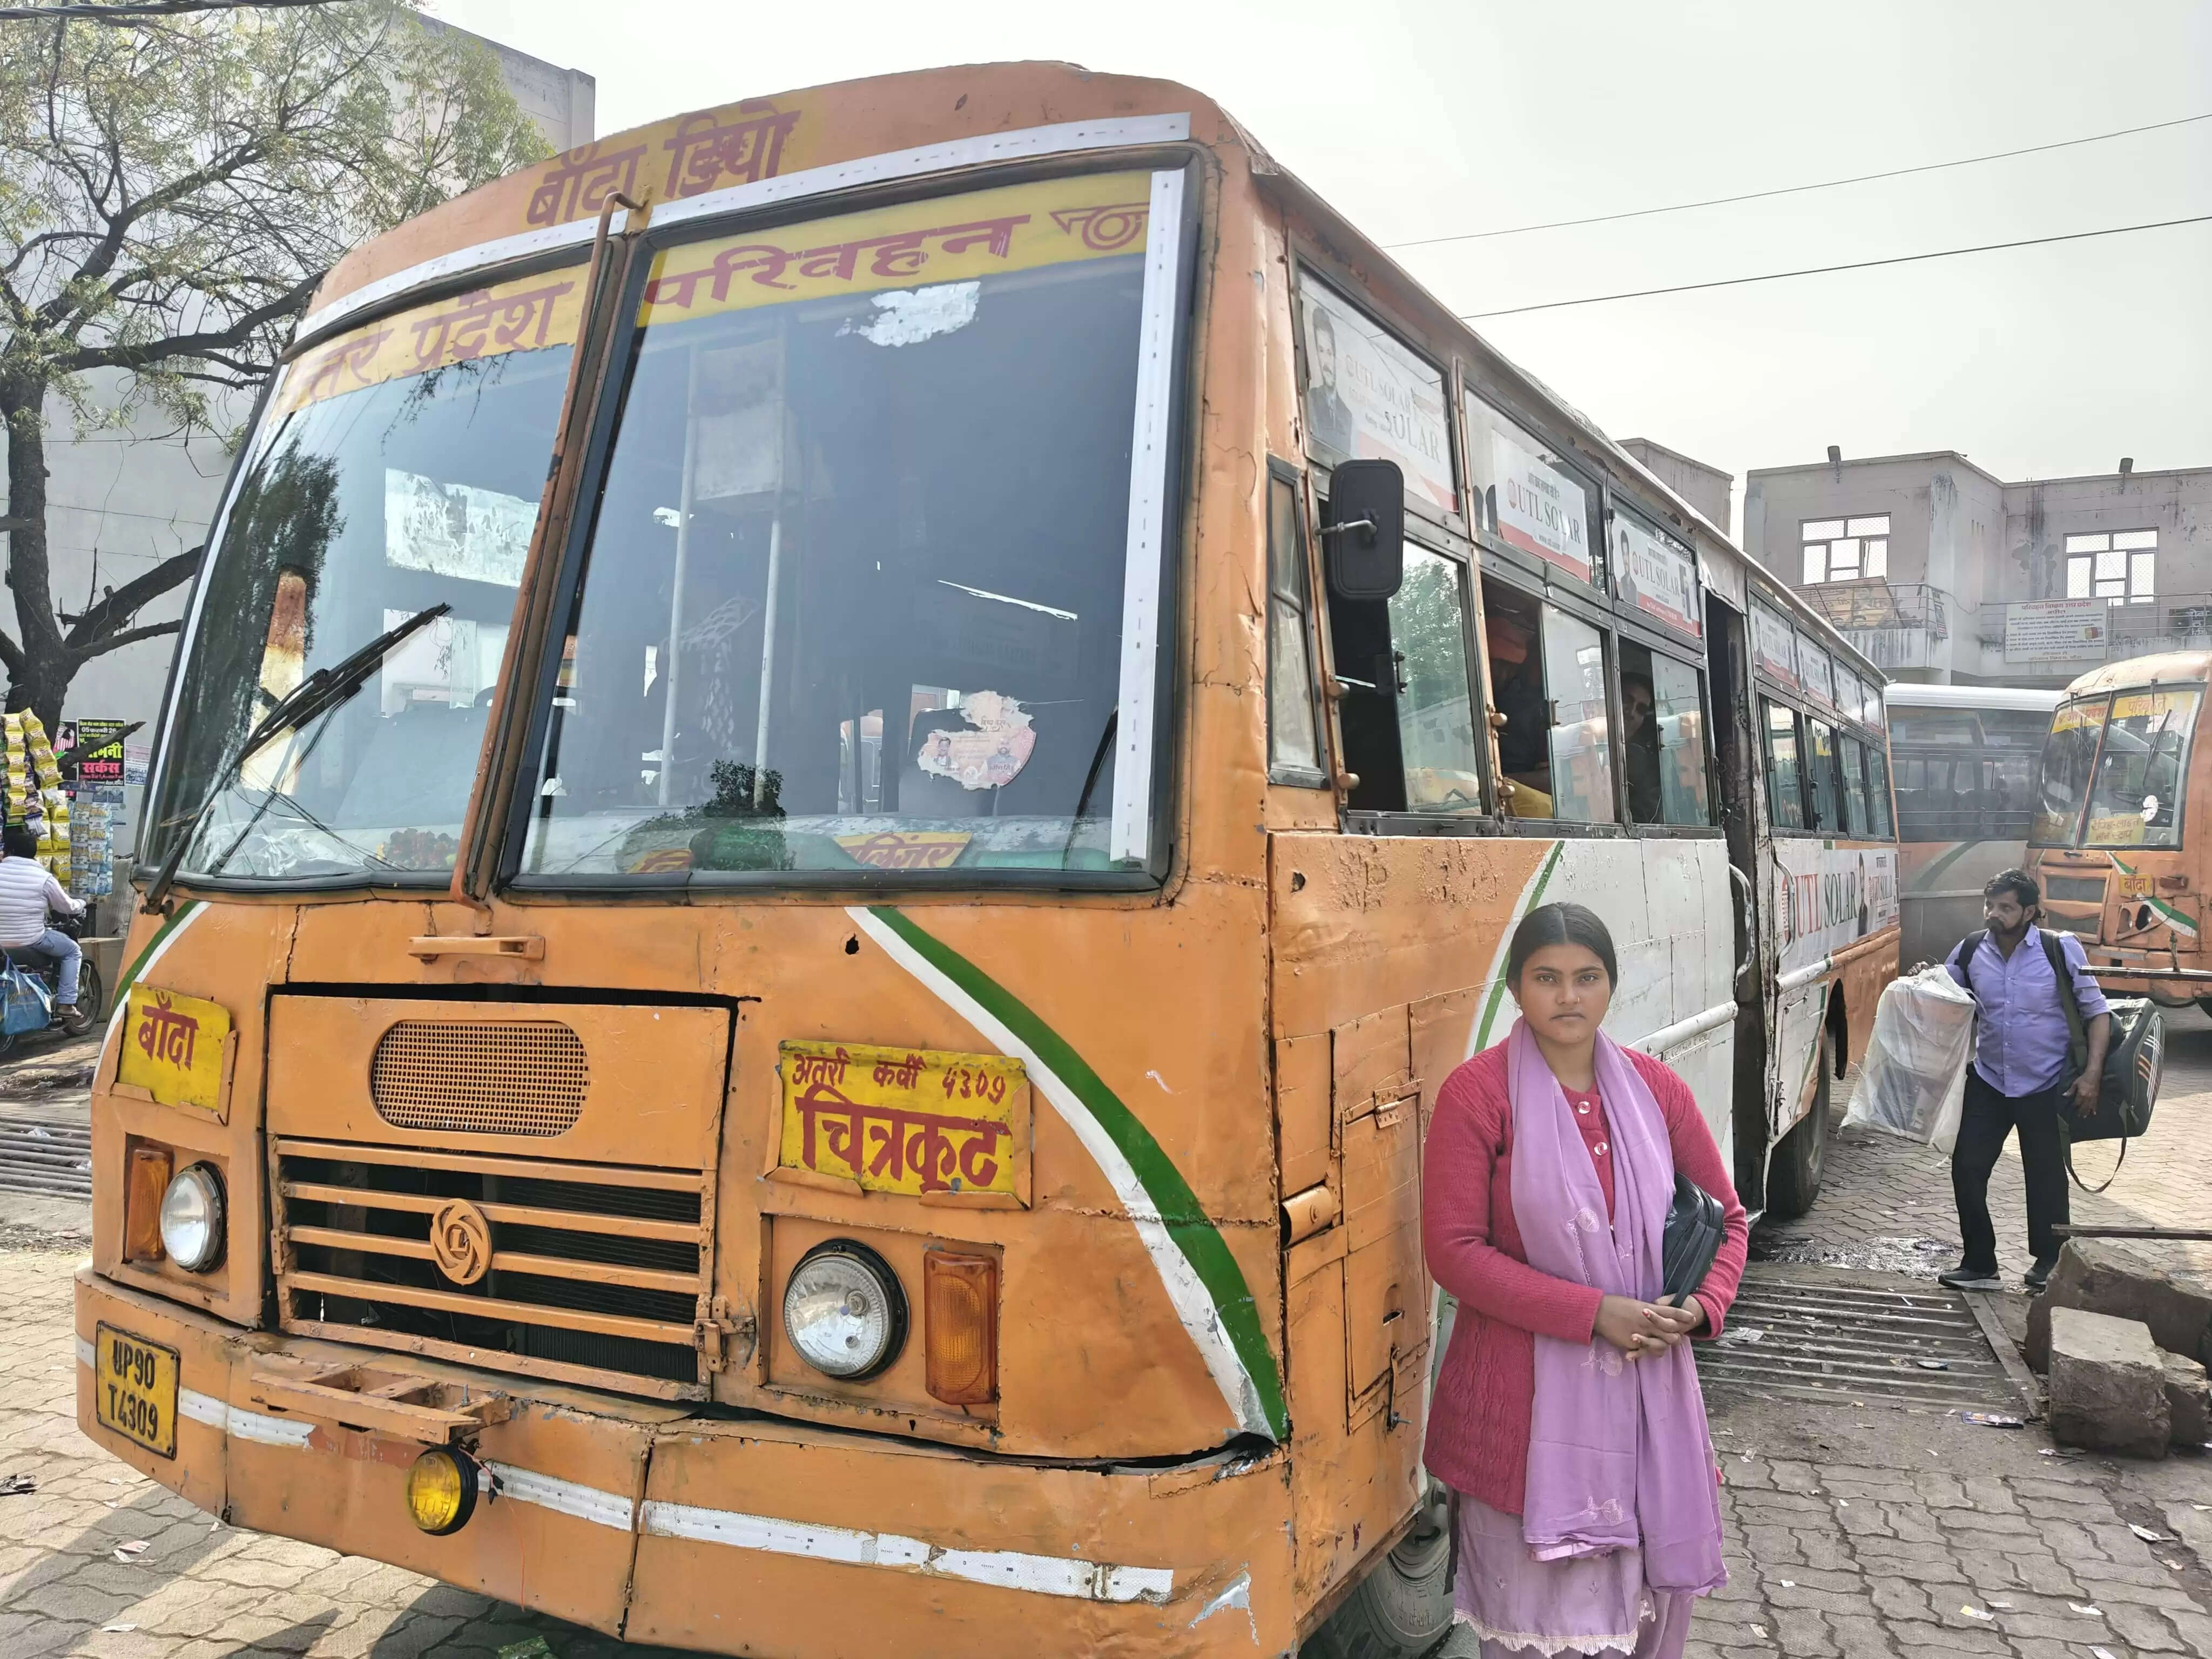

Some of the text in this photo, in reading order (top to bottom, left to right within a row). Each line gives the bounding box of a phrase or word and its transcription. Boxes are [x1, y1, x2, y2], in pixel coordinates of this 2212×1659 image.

[403, 281, 575, 377] प्रदेश
[644, 215, 1030, 309] परिवहन
[1656, 567, 1680, 597] SOLAR
[82, 759, 121, 773] सर्कस
[1795, 871, 1858, 939] UTL SOLAR
[794, 1083, 1013, 1195] चित्रकूट
[113, 1339, 156, 1390] UP90
[108, 1383, 158, 1441] T4309
